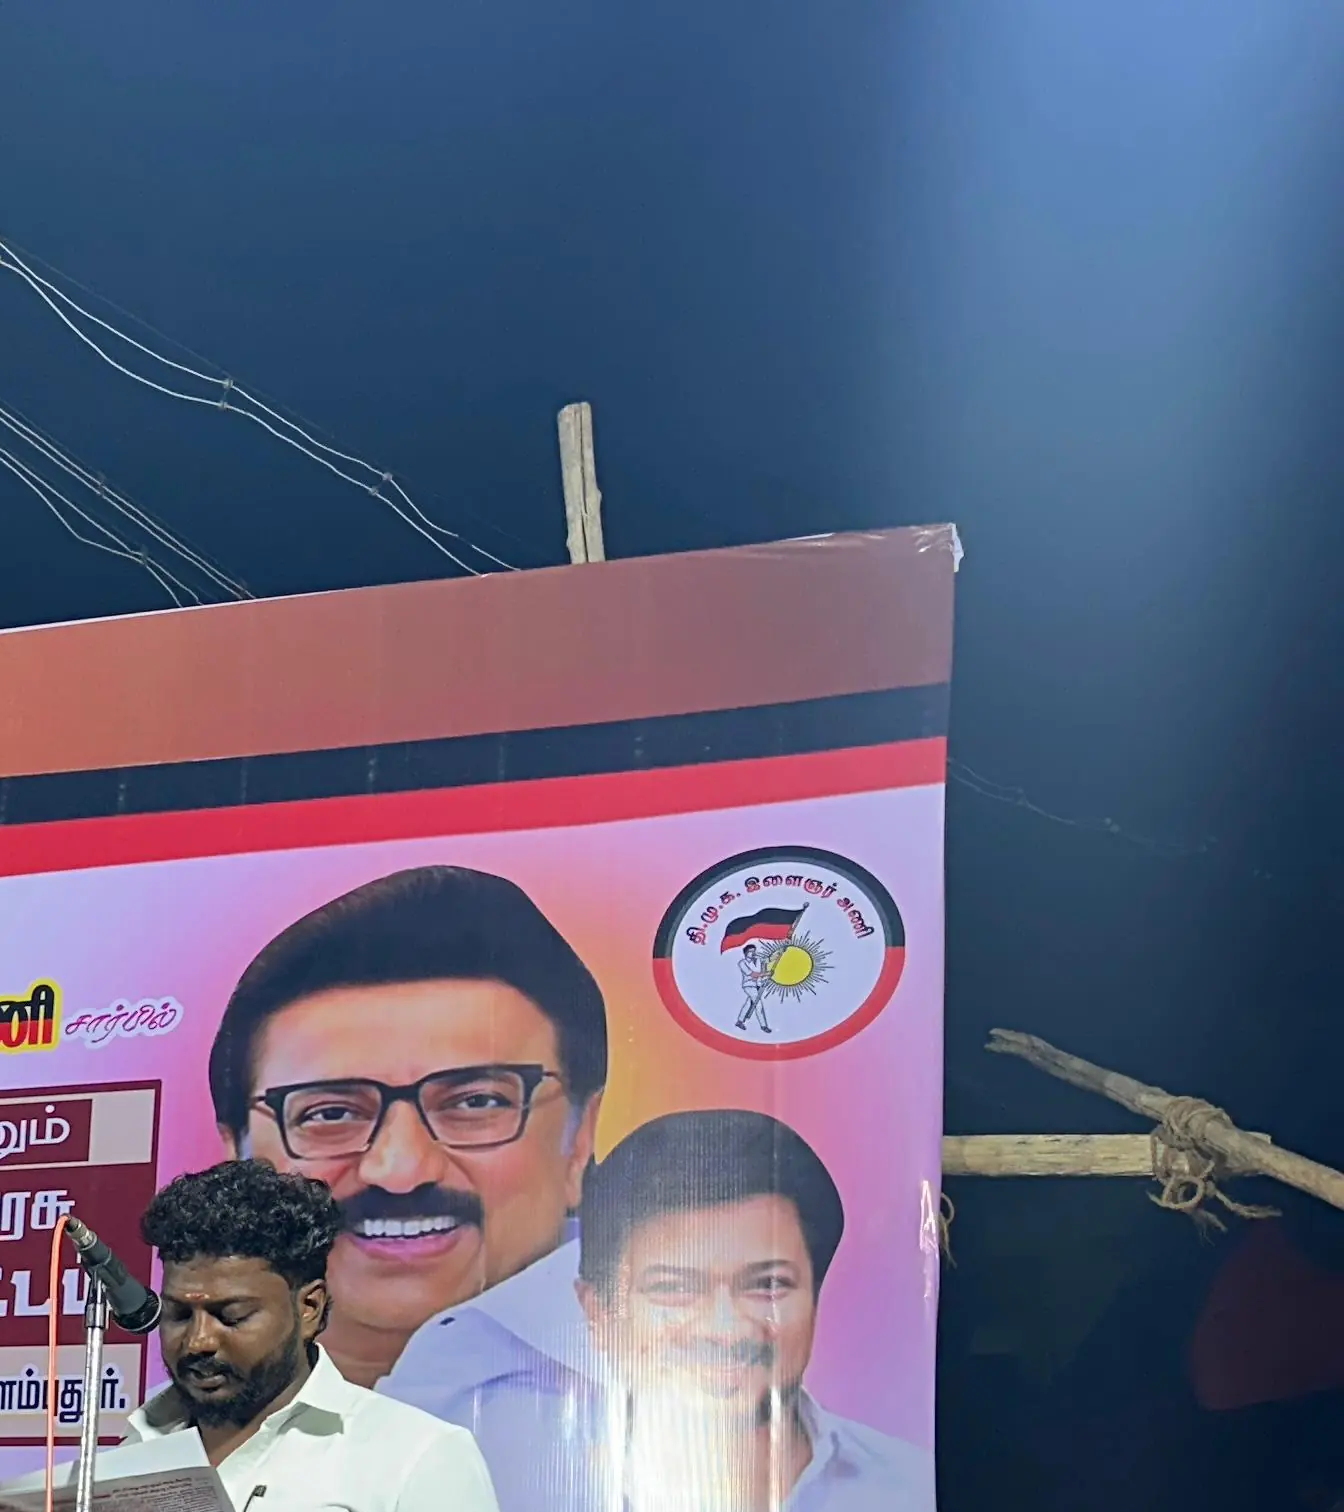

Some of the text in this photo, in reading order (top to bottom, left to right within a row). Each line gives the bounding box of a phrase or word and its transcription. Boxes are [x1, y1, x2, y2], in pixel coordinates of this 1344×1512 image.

[744, 874, 837, 898] இளைஞர்
[836, 897, 874, 939] அணி
[65, 1002, 177, 1045] சார்பில்
